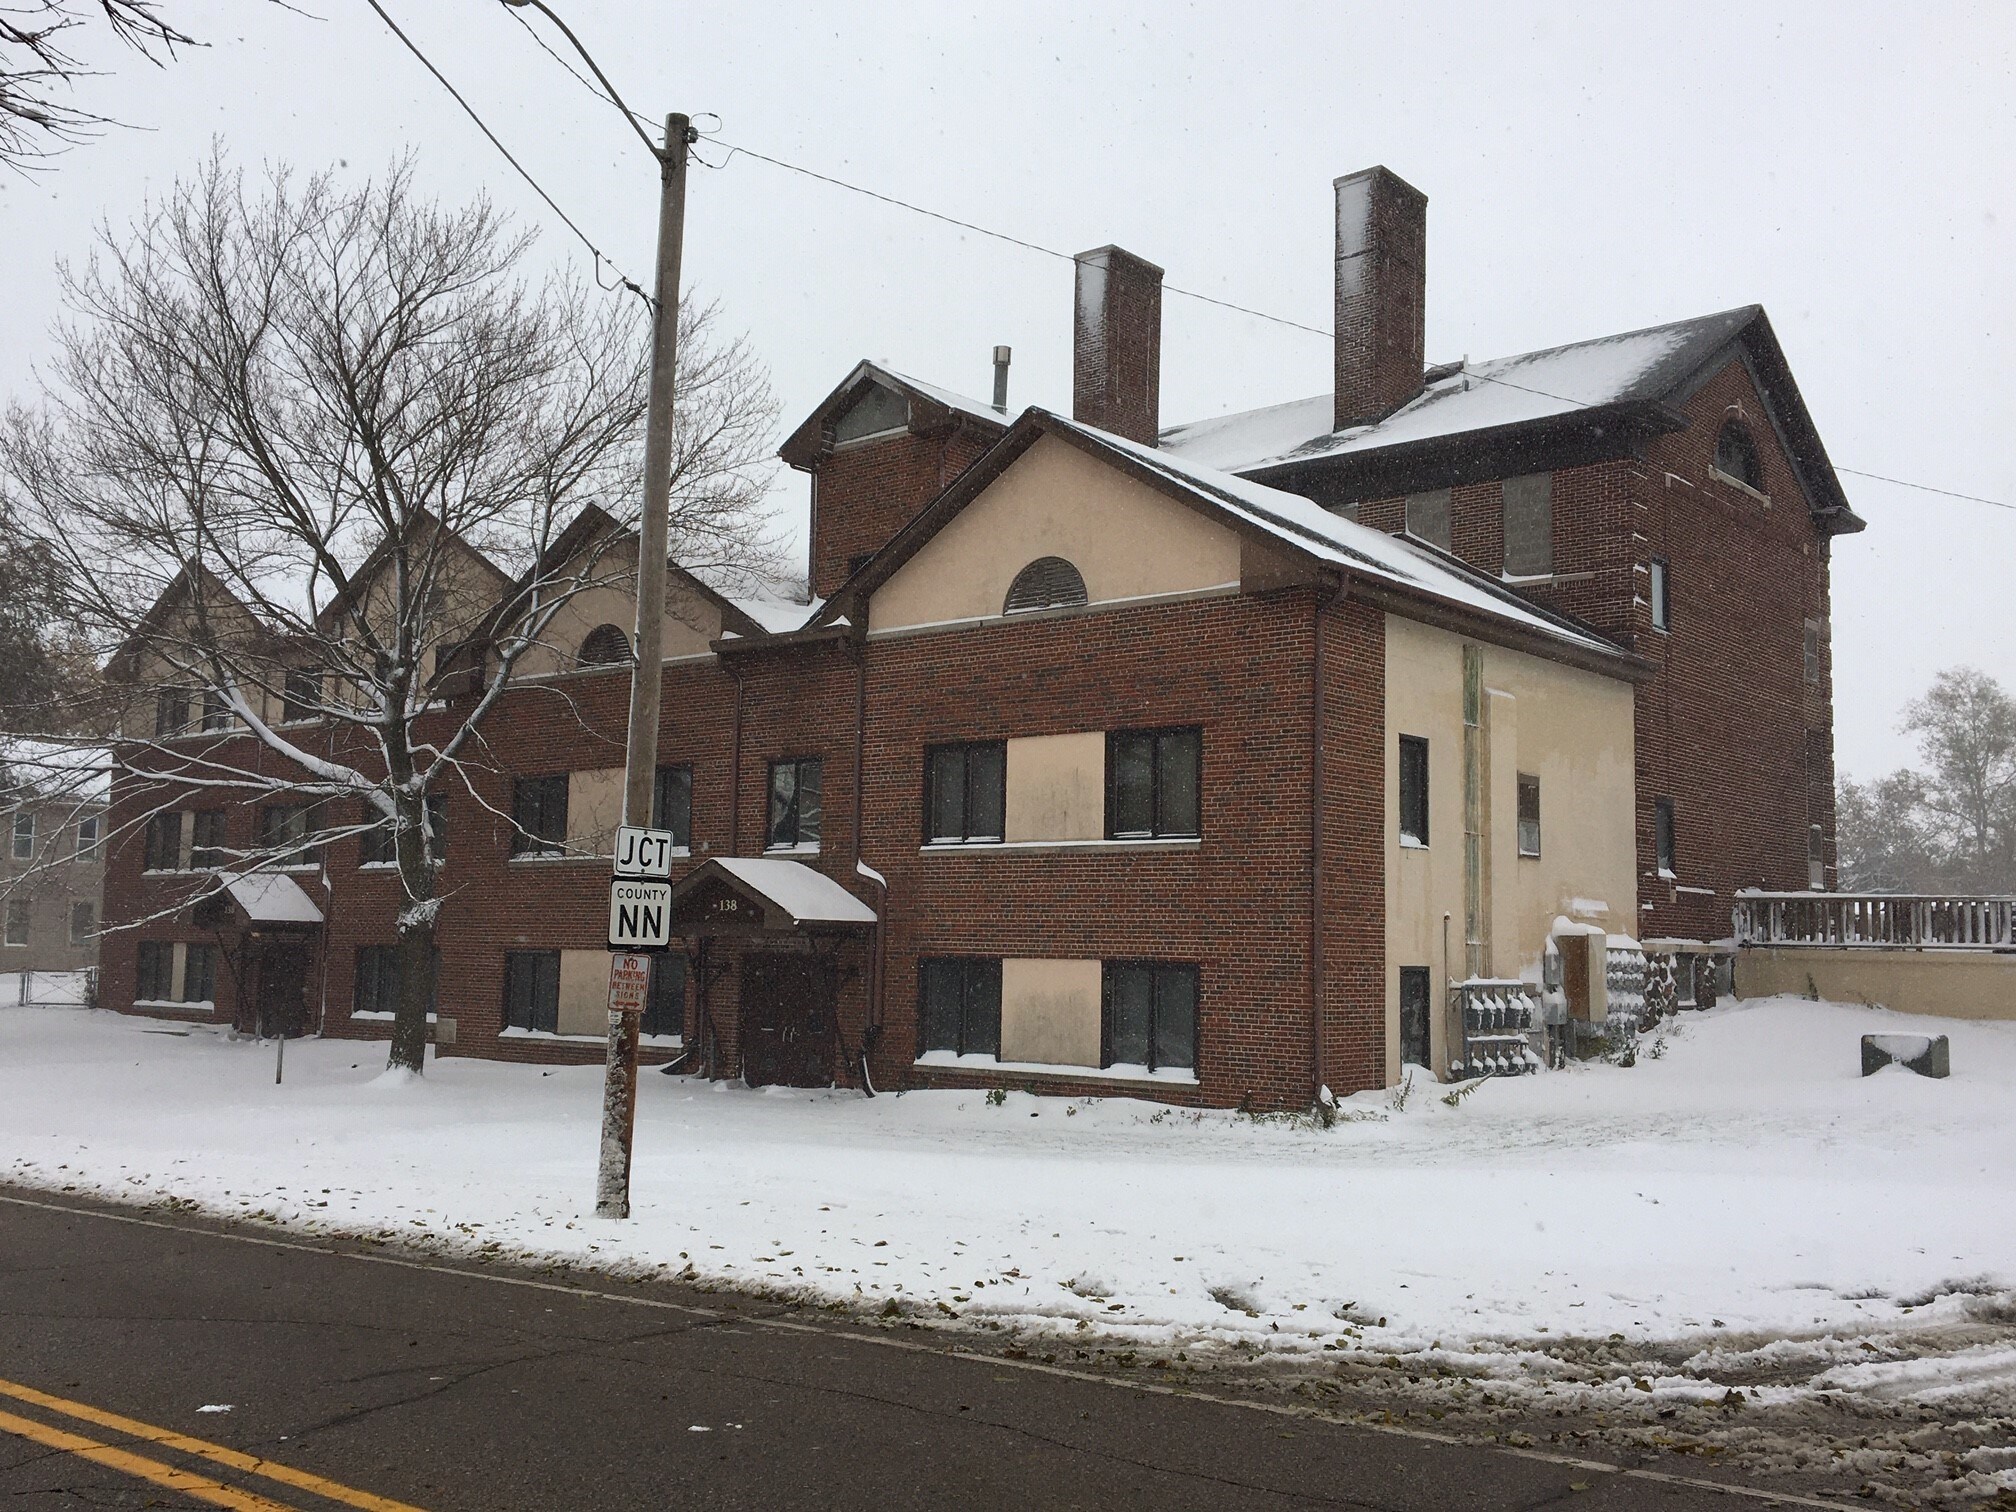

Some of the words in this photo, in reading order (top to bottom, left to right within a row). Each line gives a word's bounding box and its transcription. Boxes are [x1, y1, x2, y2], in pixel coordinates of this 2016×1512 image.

[620, 836, 668, 868] JCT
[617, 888, 667, 901] COUNTY
[719, 899, 737, 911] 138
[618, 904, 662, 938] NN
[623, 958, 638, 970] NO
[614, 969, 646, 982] PARKING
[612, 981, 646, 991] BETWEEN
[615, 990, 640, 1000] SIGNS
